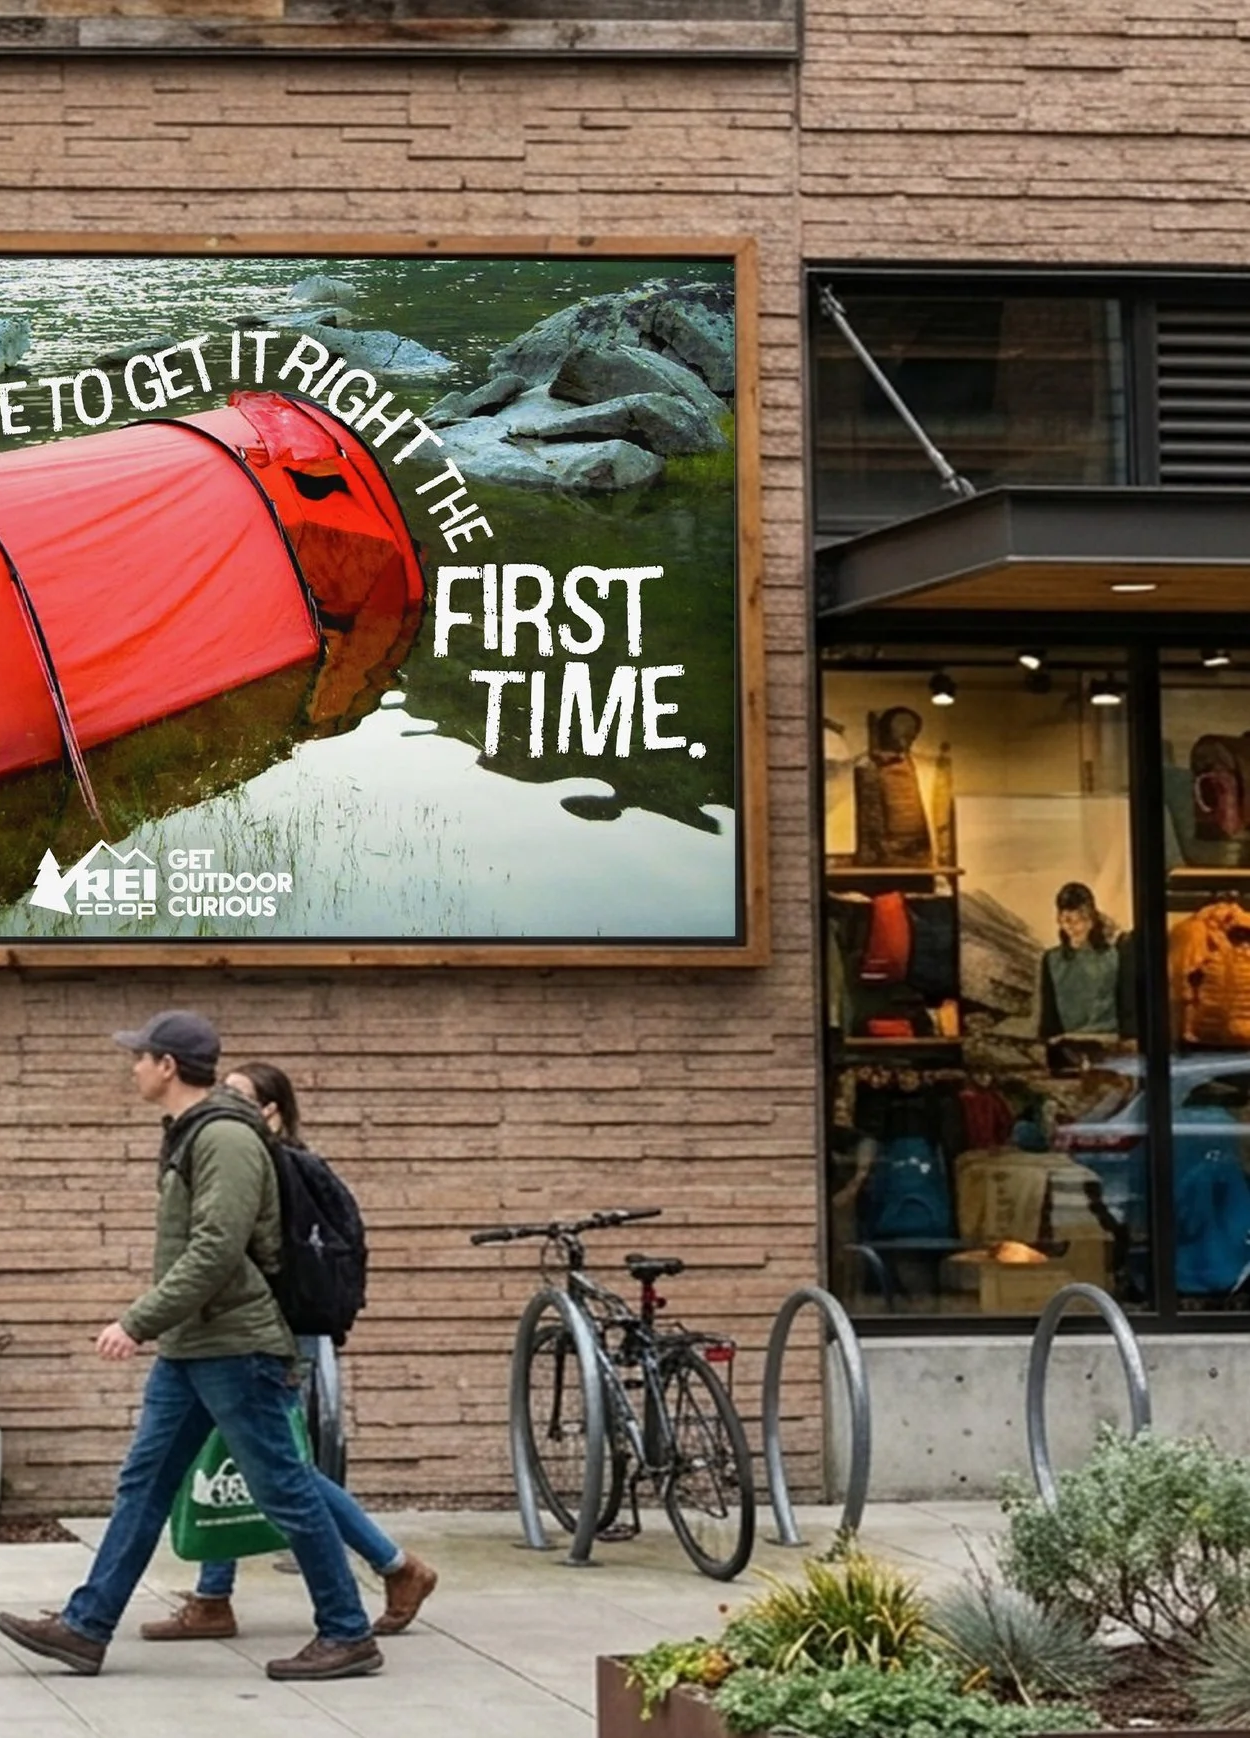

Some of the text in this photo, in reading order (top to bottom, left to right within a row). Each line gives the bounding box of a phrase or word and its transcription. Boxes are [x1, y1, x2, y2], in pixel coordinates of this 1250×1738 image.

[38, 368, 113, 433] TO
[124, 334, 212, 412] GET
[230, 330, 281, 384] IT
[277, 333, 445, 466] RIGHT
[414, 457, 495, 554] THE
[433, 563, 665, 658] FIRST
[468, 661, 708, 759] TIME.
[167, 848, 216, 870] GET
[75, 868, 157, 901] REI
[167, 872, 294, 894] OUTDOOR
[167, 895, 277, 918] CURIOUS
